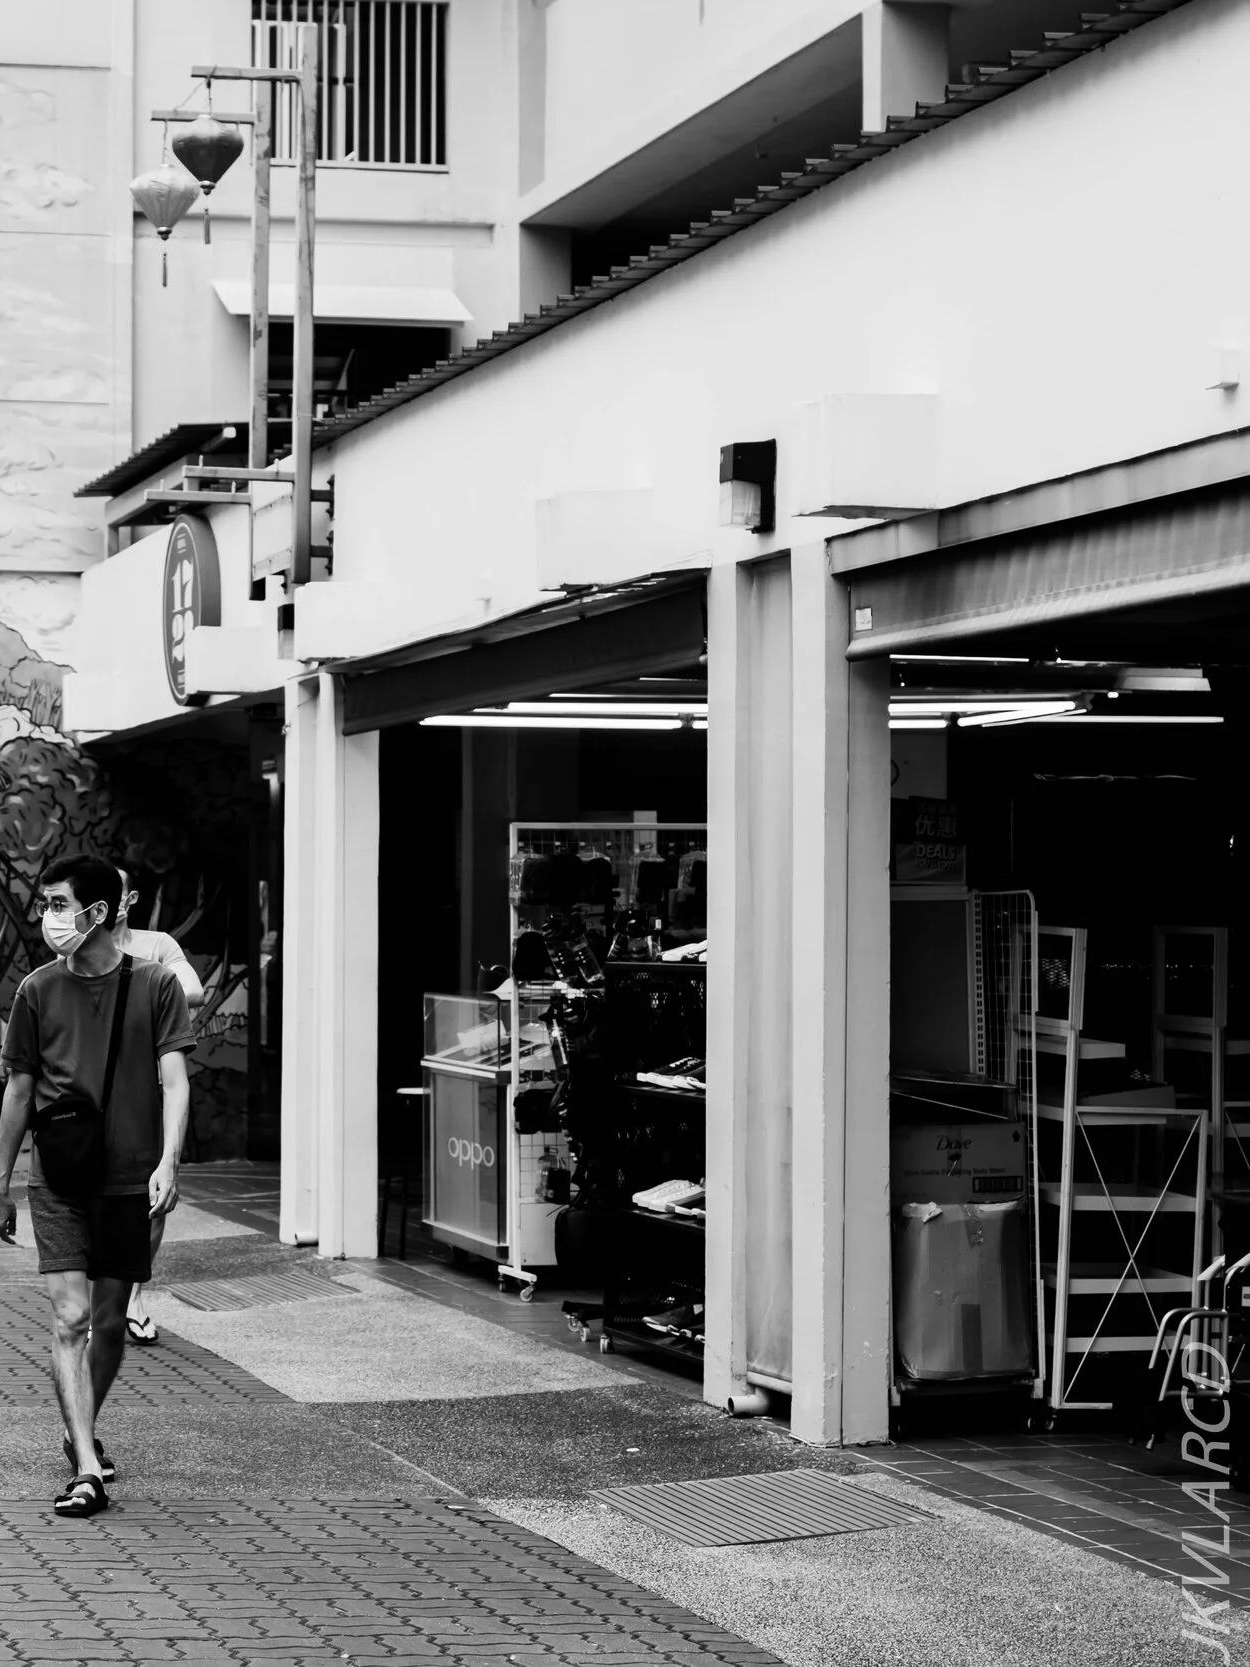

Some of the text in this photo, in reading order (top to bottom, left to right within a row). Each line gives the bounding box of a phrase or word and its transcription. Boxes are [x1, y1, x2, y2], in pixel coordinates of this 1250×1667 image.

[915, 814, 957, 838] 优惠
[916, 844, 956, 860] DEALS
[936, 1134, 972, 1151] Dove
[448, 1137, 495, 1170] oppo
